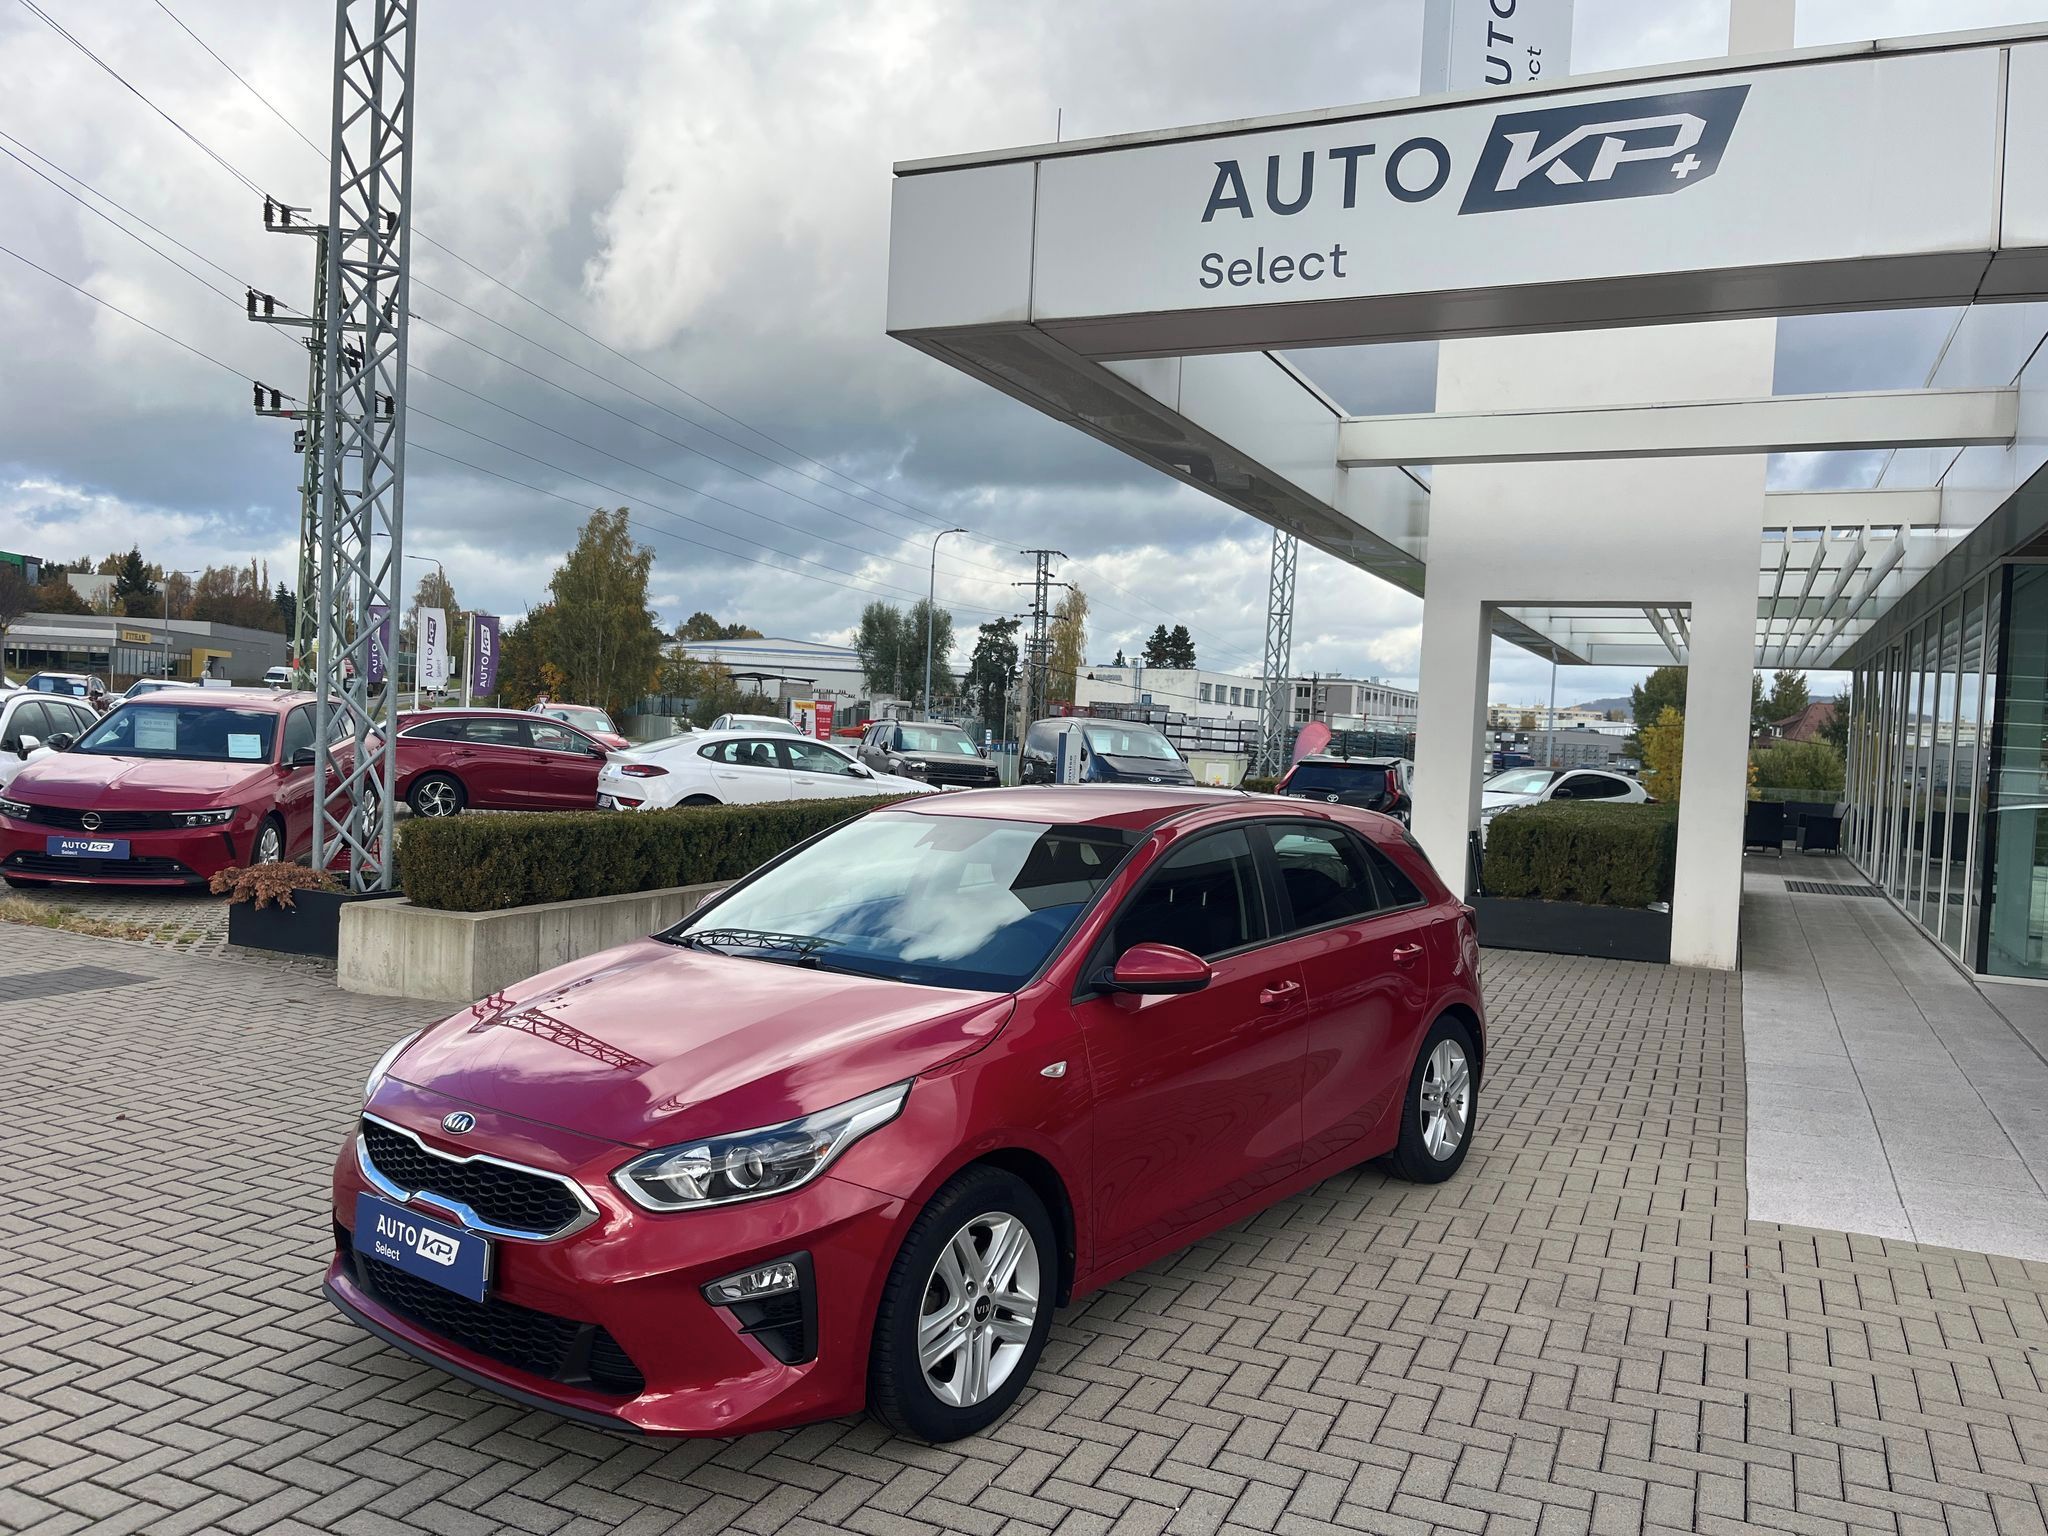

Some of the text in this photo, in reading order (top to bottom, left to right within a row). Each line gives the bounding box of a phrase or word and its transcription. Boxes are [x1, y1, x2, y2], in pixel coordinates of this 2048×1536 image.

[1485, 0, 1516, 85] UTO
[1527, 46, 1542, 81] ct
[1201, 136, 1451, 223] AUTO
[1199, 243, 1347, 289] Select
[480, 656, 489, 688] AUTO
[61, 841, 88, 849] AUTO
[444, 1113, 470, 1131] KIA
[376, 1214, 417, 1246] AUTO
[375, 1241, 400, 1261] Select
